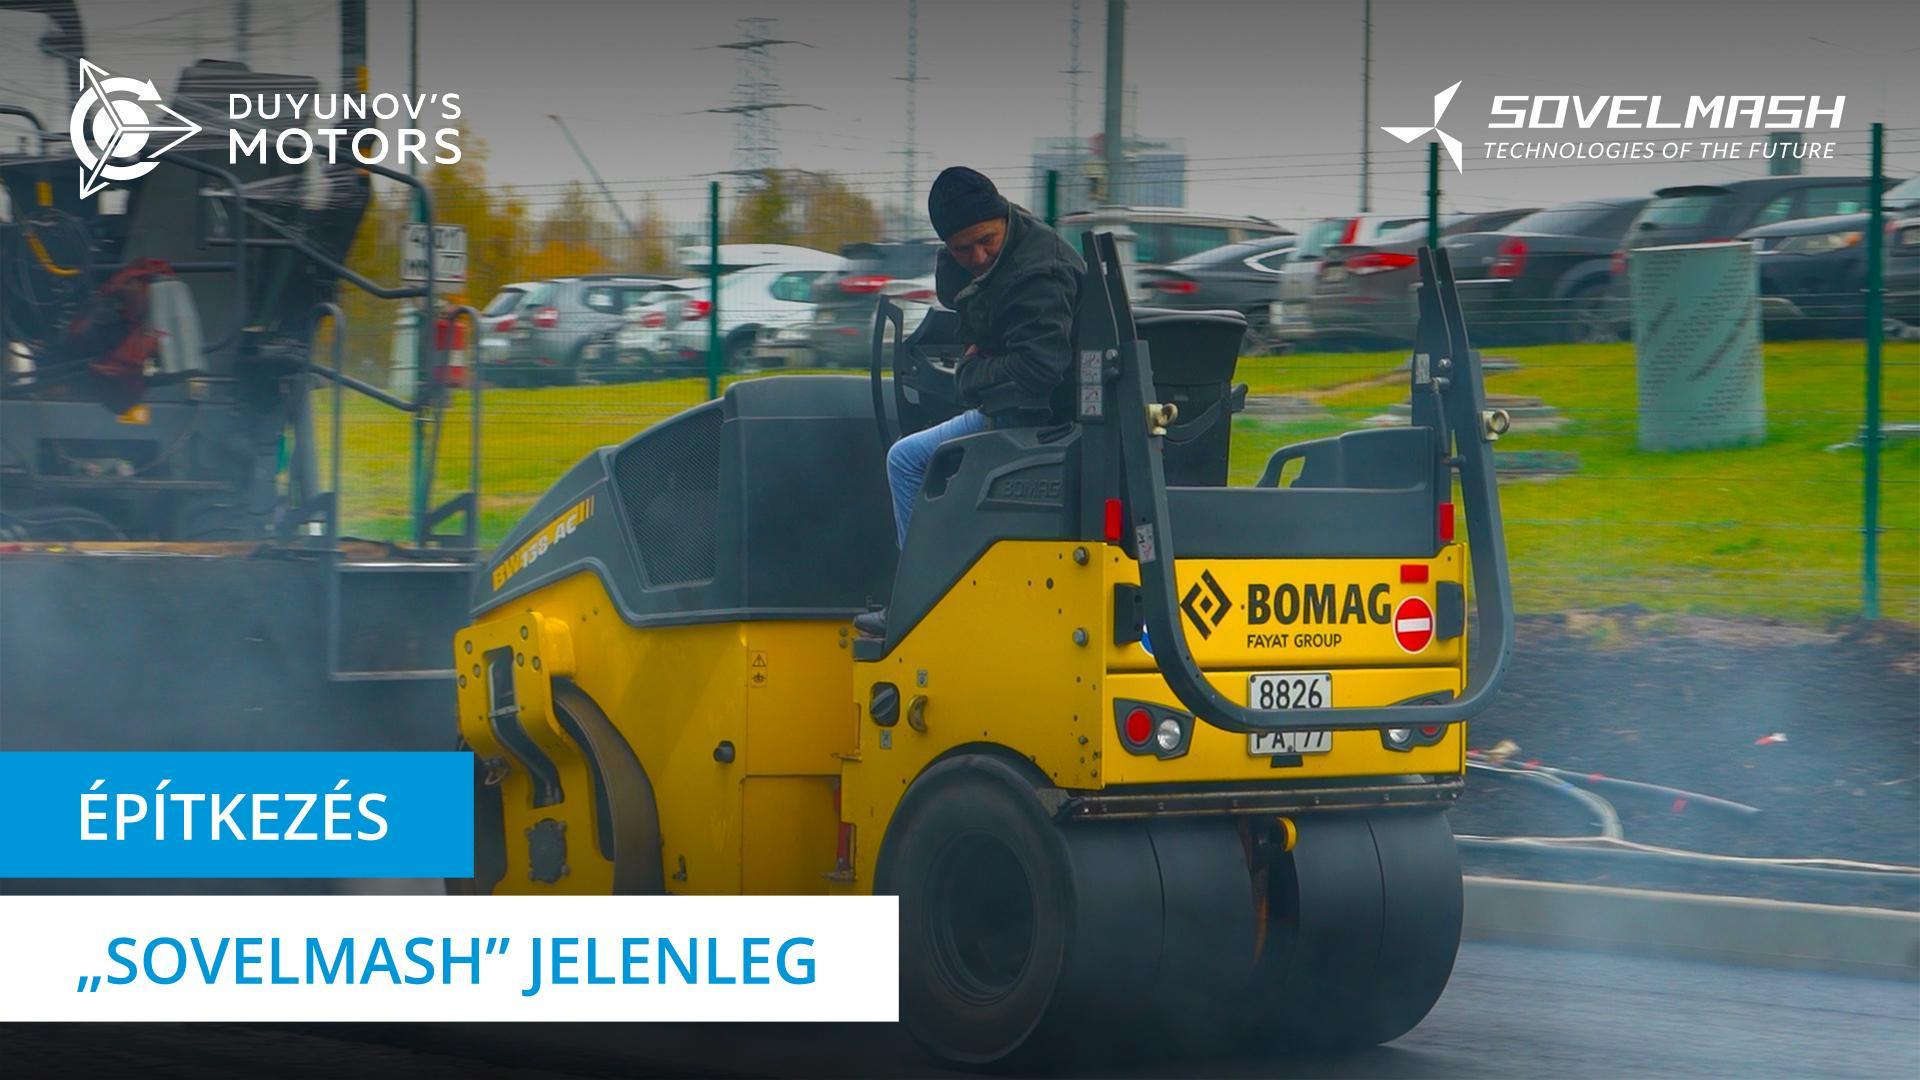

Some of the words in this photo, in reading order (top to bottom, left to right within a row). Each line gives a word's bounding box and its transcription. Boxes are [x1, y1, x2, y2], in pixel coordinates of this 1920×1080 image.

[1247, 582, 1392, 625] BOMAG
[1247, 633, 1289, 648] FAYAT
[1293, 633, 1342, 648] GROUP
[1260, 678, 1323, 710] 8826
